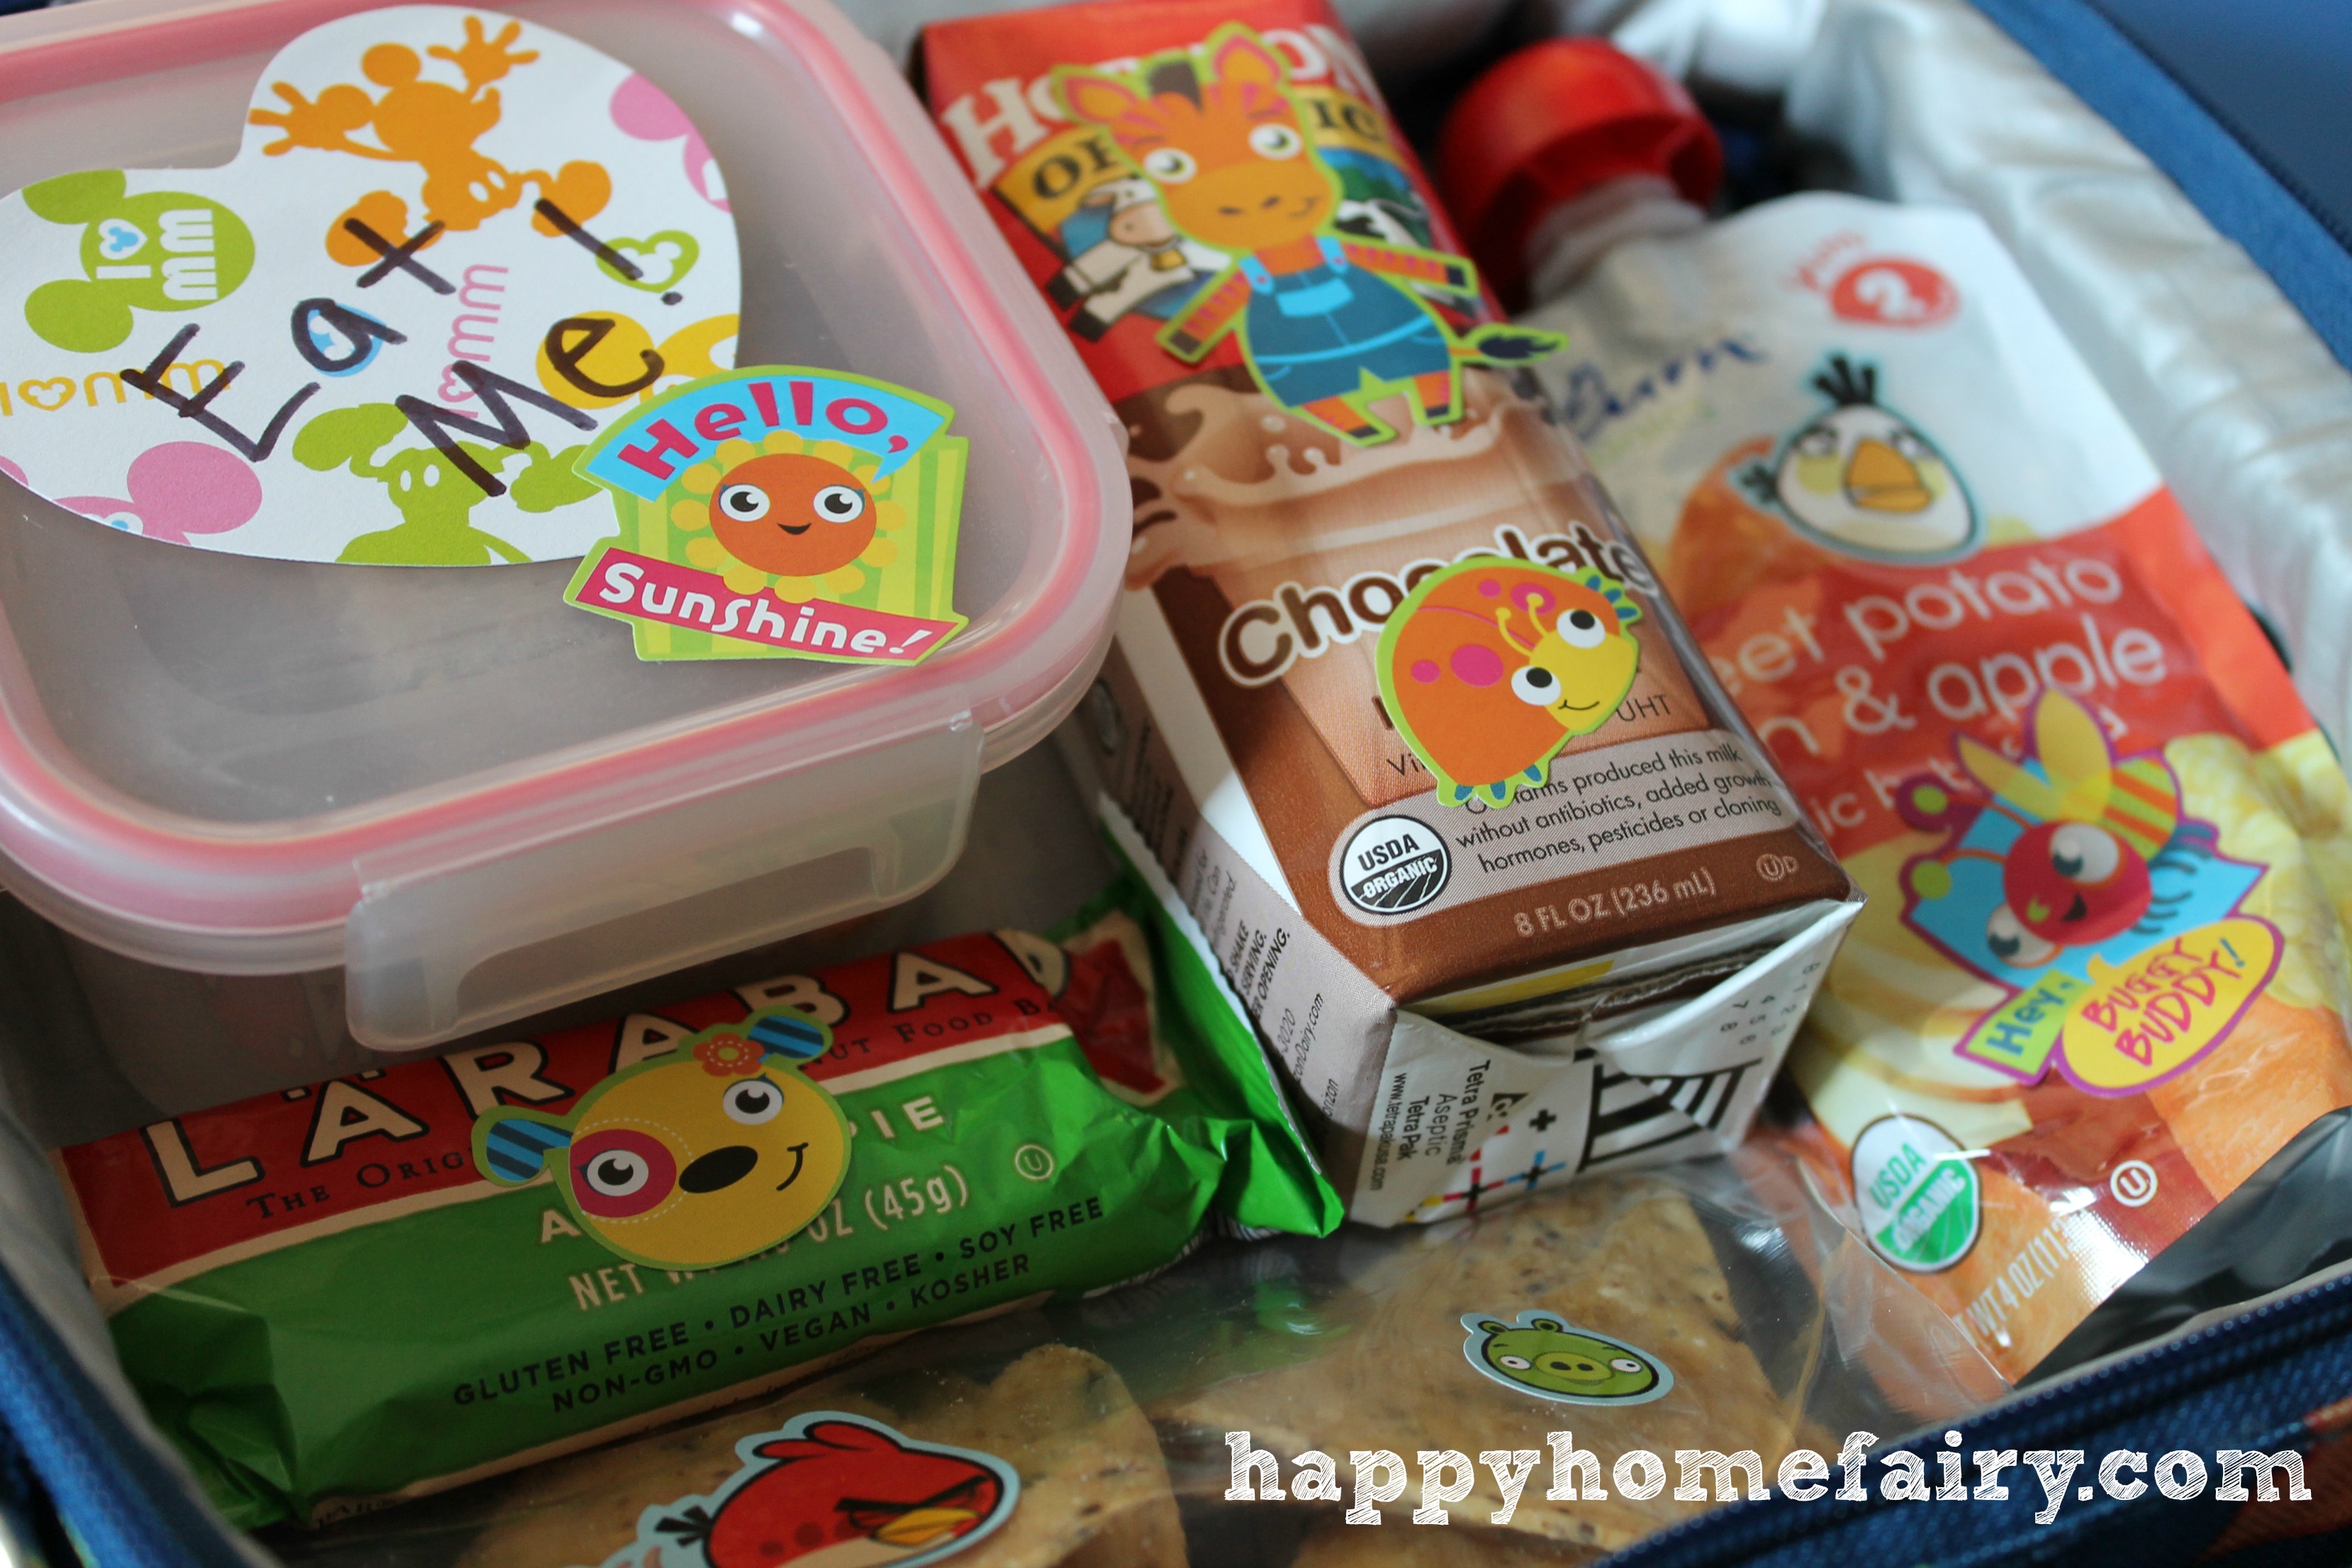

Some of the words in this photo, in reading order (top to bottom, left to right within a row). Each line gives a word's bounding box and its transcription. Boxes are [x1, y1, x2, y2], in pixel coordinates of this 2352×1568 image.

[118, 216, 455, 462] Eat
[617, 381, 908, 481] Hello,
[598, 561, 933, 655] Sunshine!
[1221, 522, 1657, 683] Cholate
[1705, 606, 1824, 698] eet
[1844, 558, 2122, 661] potato
[1615, 694, 1671, 722] UHT
[1835, 665, 1917, 734] &
[1927, 614, 2166, 722] apple
[1572, 751, 1667, 797] produced
[1669, 748, 1703, 769] this
[1707, 744, 1744, 770] milk
[1455, 816, 1531, 848] without
[1535, 795, 1643, 829] antibiotics,
[1646, 773, 1710, 803] added
[1714, 770, 1772, 795] growth
[1477, 837, 1586, 873] hormones,
[1587, 812, 1684, 853] pesticides
[1688, 808, 1709, 824] or
[1713, 797, 1782, 817] cloning
[1357, 833, 1421, 872] USDA
[1362, 855, 1438, 899] ORGANIC
[1514, 912, 1535, 937] 8
[1535, 905, 1567, 932] FL
[1567, 893, 1611, 923] OZ
[1611, 879, 1670, 917] (236
[1230, 919, 1250, 974] SHAKE
[1239, 929, 1267, 995] SERVING.
[1257, 927, 1291, 1000] OPENING.
[2080, 936, 2203, 1034] BUGGY
[2114, 937, 2246, 1068] BUDDY!
[797, 1037, 871, 1070] UT
[892, 1012, 994, 1044] FOOD
[1291, 992, 1325, 1082] zonDairy.com
[851, 1096, 945, 1139] IE
[1321, 1077, 1339, 1118] orizon
[1403, 1095, 1430, 1133] Tetra
[1461, 1059, 1491, 1107] Tetra
[1396, 1133, 1421, 1163] Pak
[1424, 1092, 1458, 1157] Aseptic
[1869, 1142, 1927, 1211] USDA
[1891, 1167, 1967, 1254] ORGANIC
[569, 1263, 645, 1311] NET
[864, 1164, 969, 1231] (45g)
[453, 1350, 590, 1406] GLUTEN
[603, 1321, 690, 1365] FREE
[729, 1280, 827, 1329] DAIRY
[841, 1253, 922, 1296] FREE
[959, 1223, 1017, 1260] SOY
[1029, 1197, 1104, 1238] FREE
[1994, 1275, 2021, 1310] 4
[552, 1349, 718, 1413] NON-GMO
[759, 1302, 871, 1352] VEGAN
[910, 1253, 1030, 1309] KOSHER
